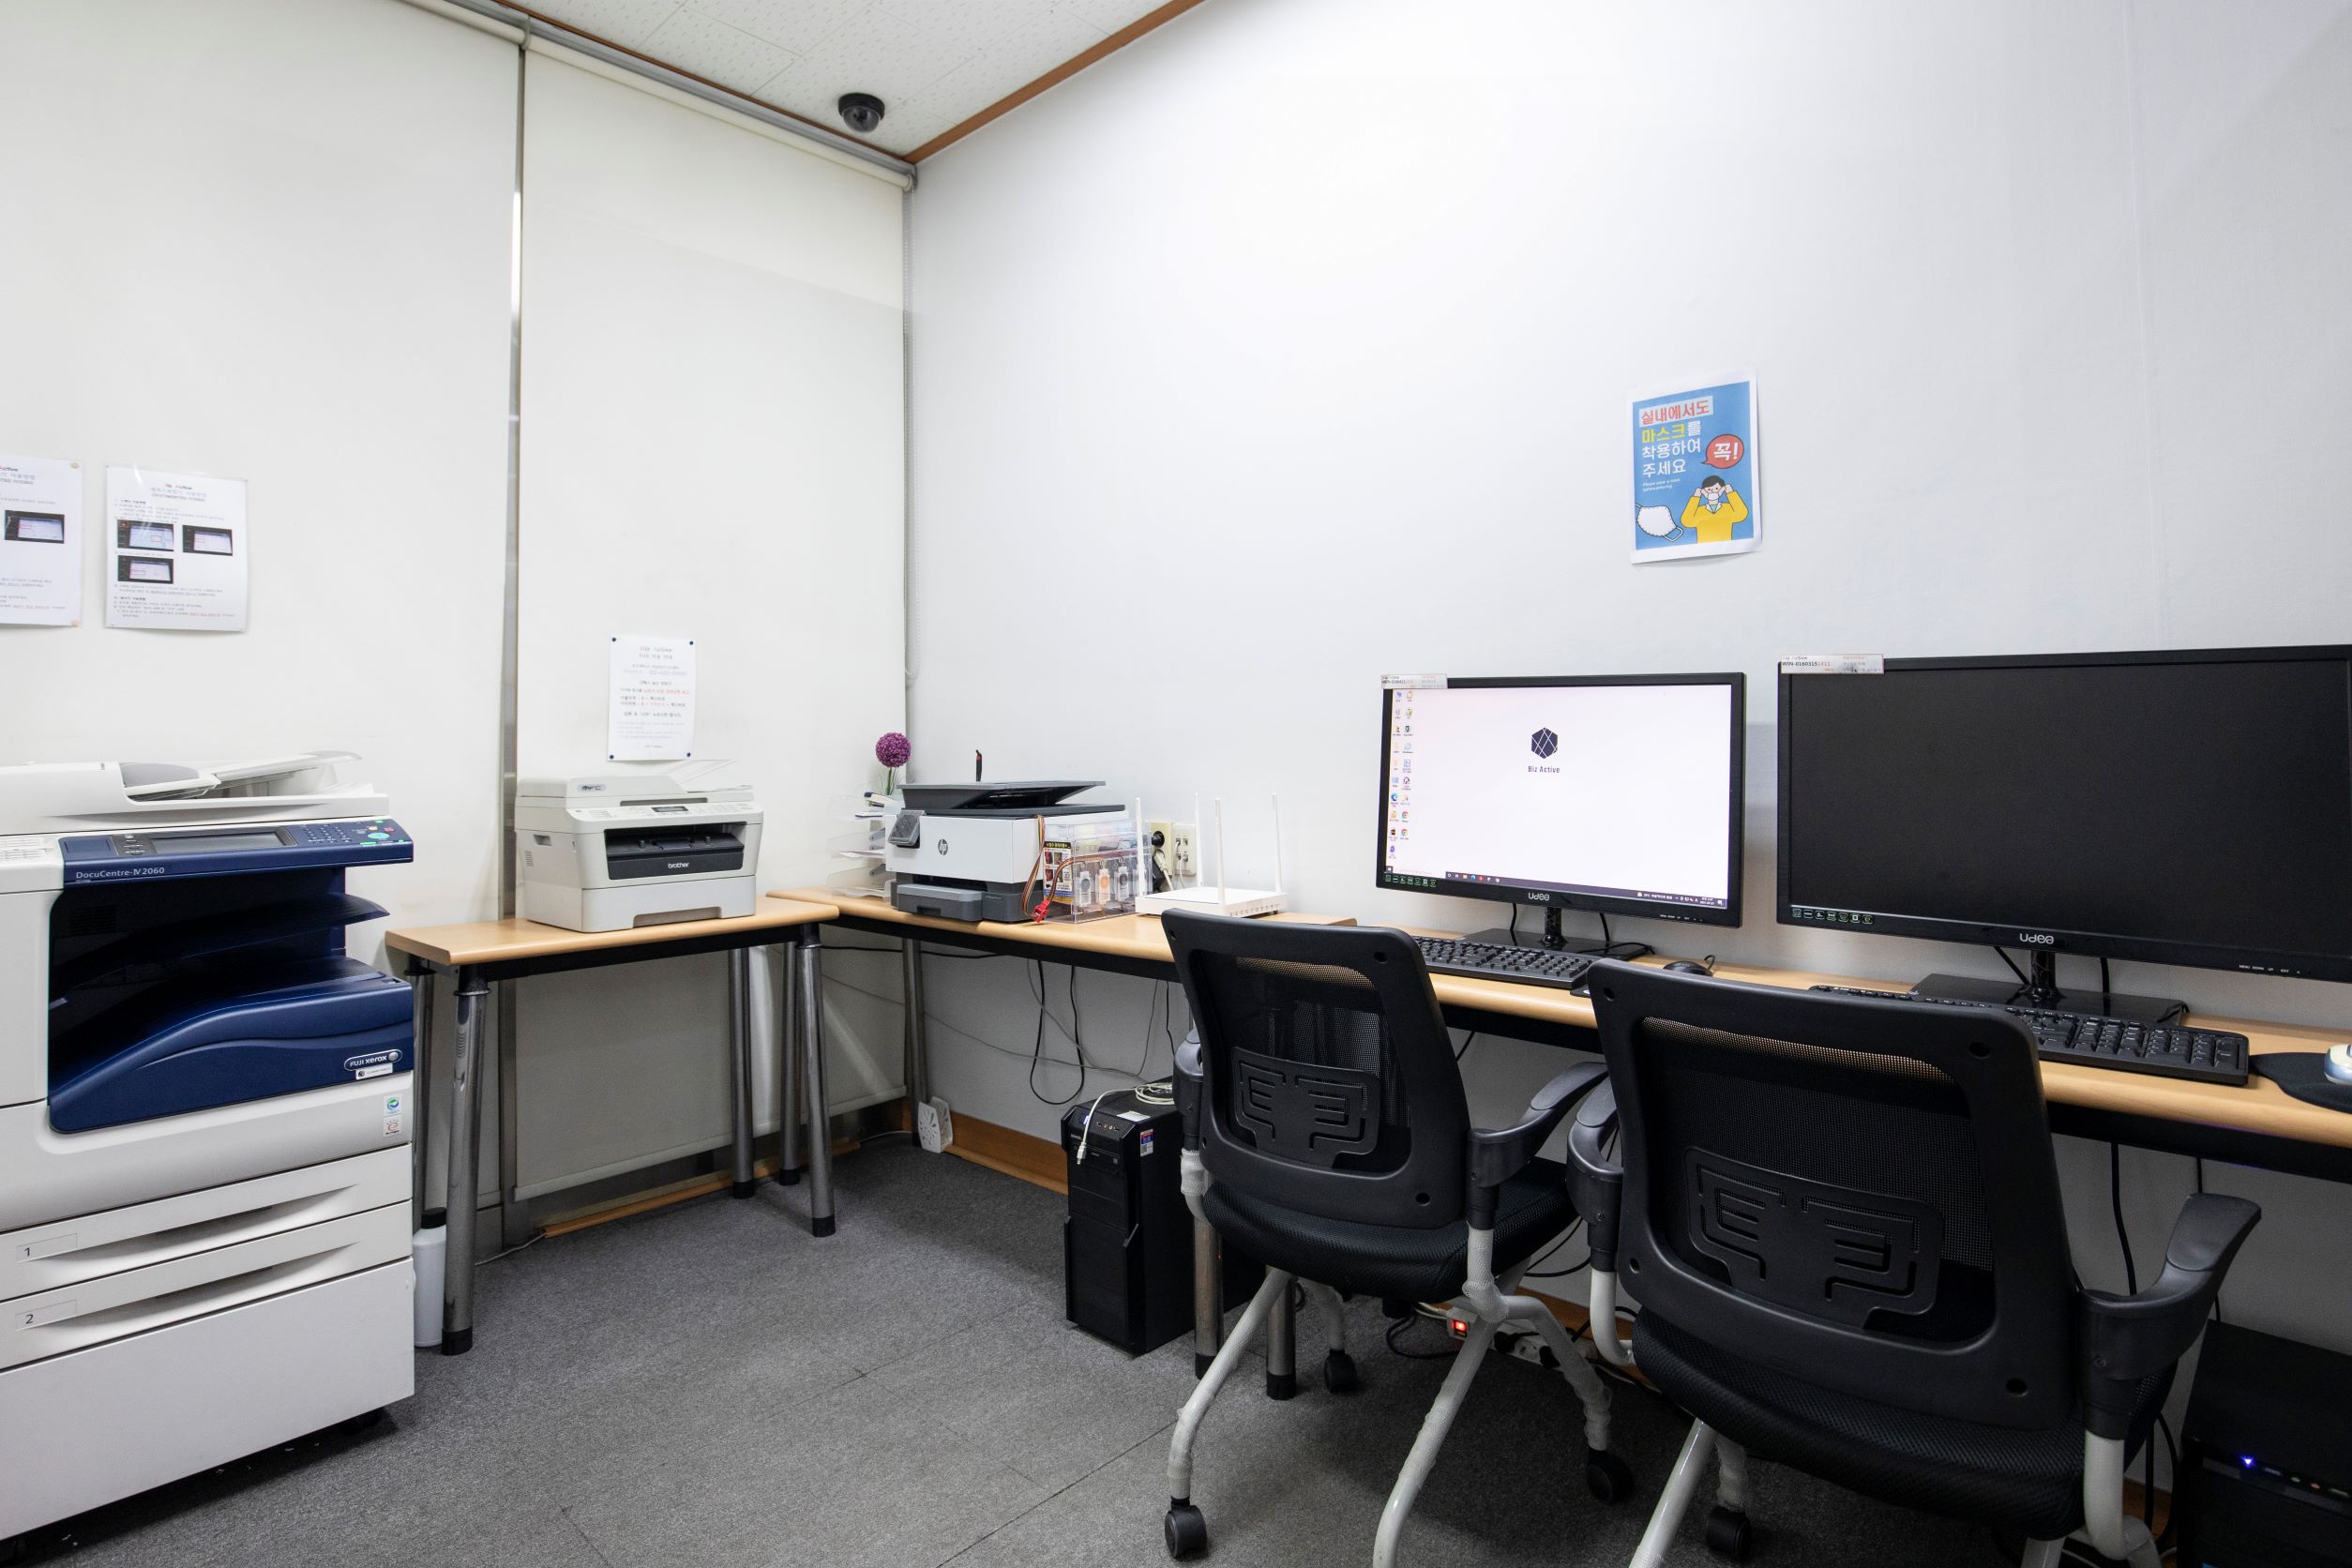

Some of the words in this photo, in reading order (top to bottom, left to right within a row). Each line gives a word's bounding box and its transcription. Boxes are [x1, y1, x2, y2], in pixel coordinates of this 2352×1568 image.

[1641, 400, 1710, 425] 실내에서도
[1642, 420, 1701, 444] 마스크를
[1642, 438, 1701, 460] 착용하여
[1713, 443, 1739, 460] 꼭!
[1643, 460, 1686, 478] 주세요
[1539, 765, 1560, 774] Active
[938, 838, 948, 856] hp
[142, 867, 165, 875] 2060
[365, 1055, 387, 1064] xerox
[23, 1246, 30, 1258] 1
[25, 1314, 34, 1324] 2
